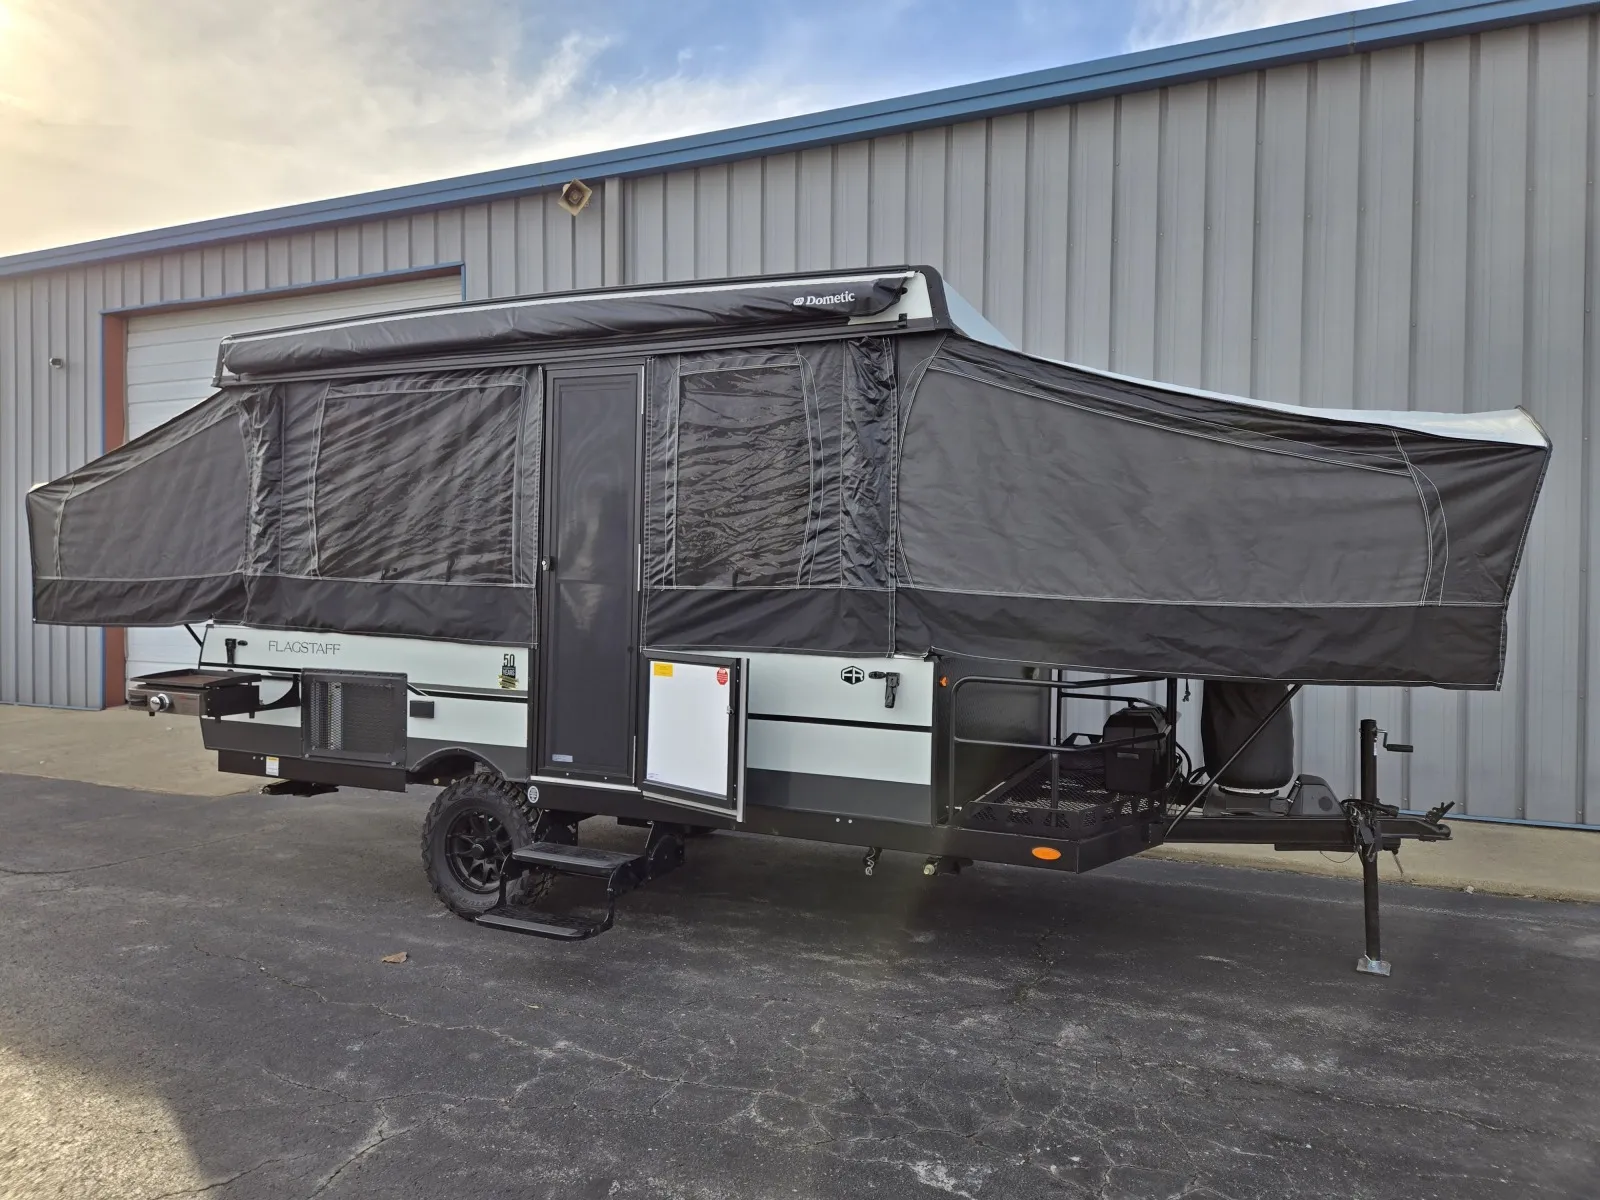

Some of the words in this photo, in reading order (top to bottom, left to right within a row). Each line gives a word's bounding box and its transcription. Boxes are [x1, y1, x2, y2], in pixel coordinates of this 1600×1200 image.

[805, 290, 855, 305] Dometic
[268, 640, 341, 655] FLAGSTAFF
[503, 653, 515, 668] 50
